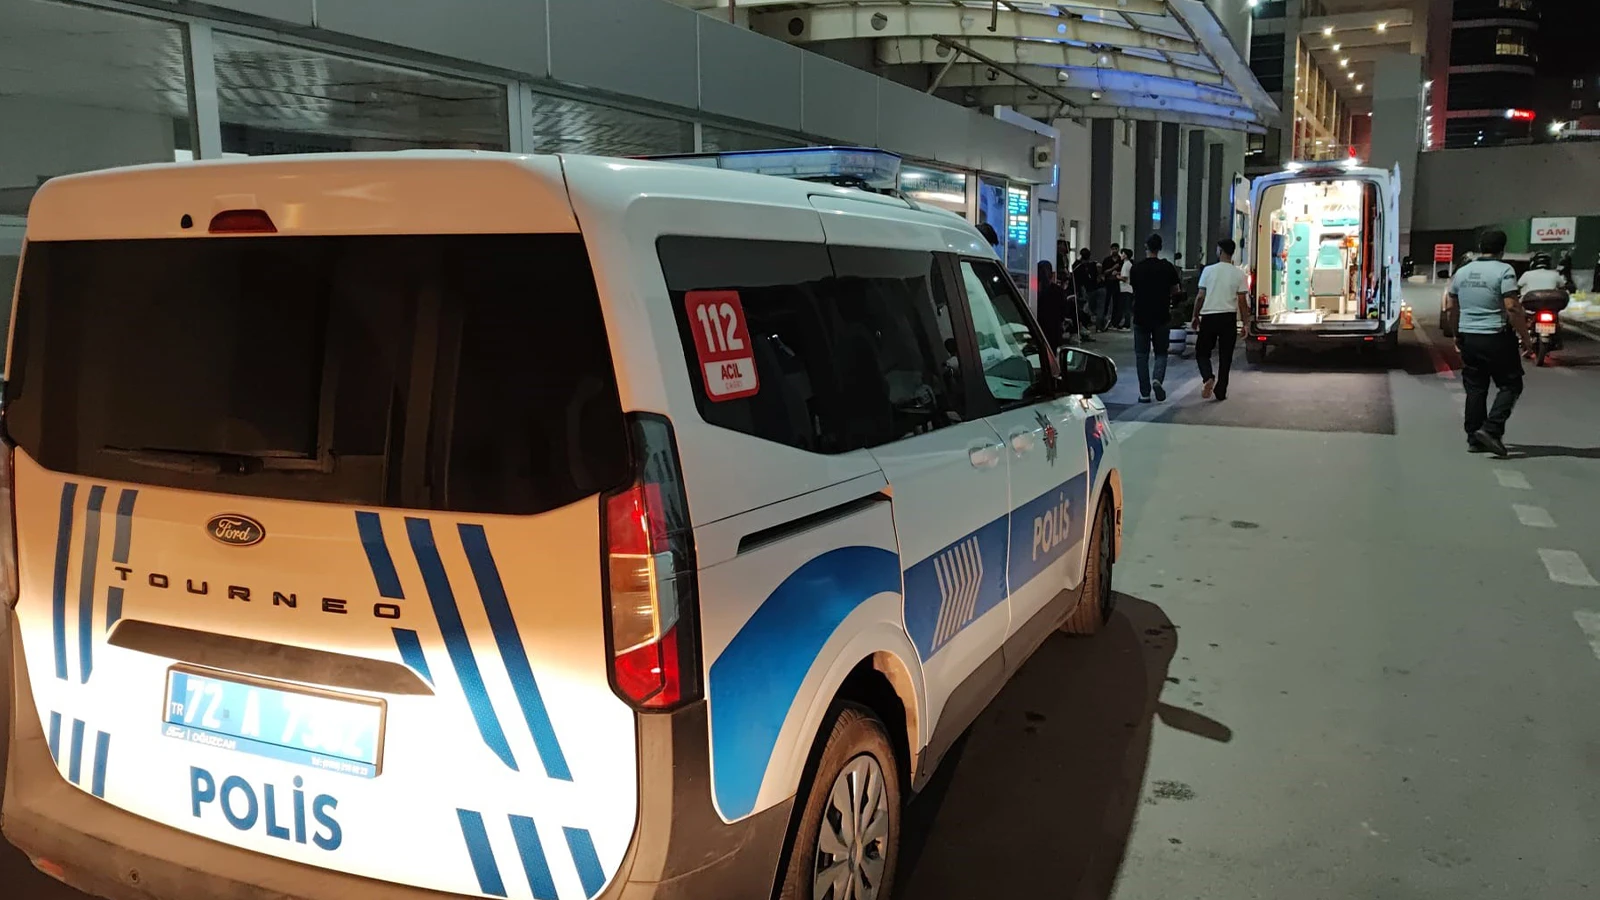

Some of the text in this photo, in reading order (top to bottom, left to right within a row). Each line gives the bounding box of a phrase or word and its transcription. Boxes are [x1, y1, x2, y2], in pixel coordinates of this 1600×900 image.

[697, 303, 744, 352] 112
[215, 517, 251, 542] Ford
[1033, 491, 1070, 561] POLİS
[114, 566, 401, 619] TOURNEO
[171, 702, 184, 717] TR
[183, 678, 224, 728] 72
[241, 688, 260, 738] A
[190, 765, 342, 851] POLİS
